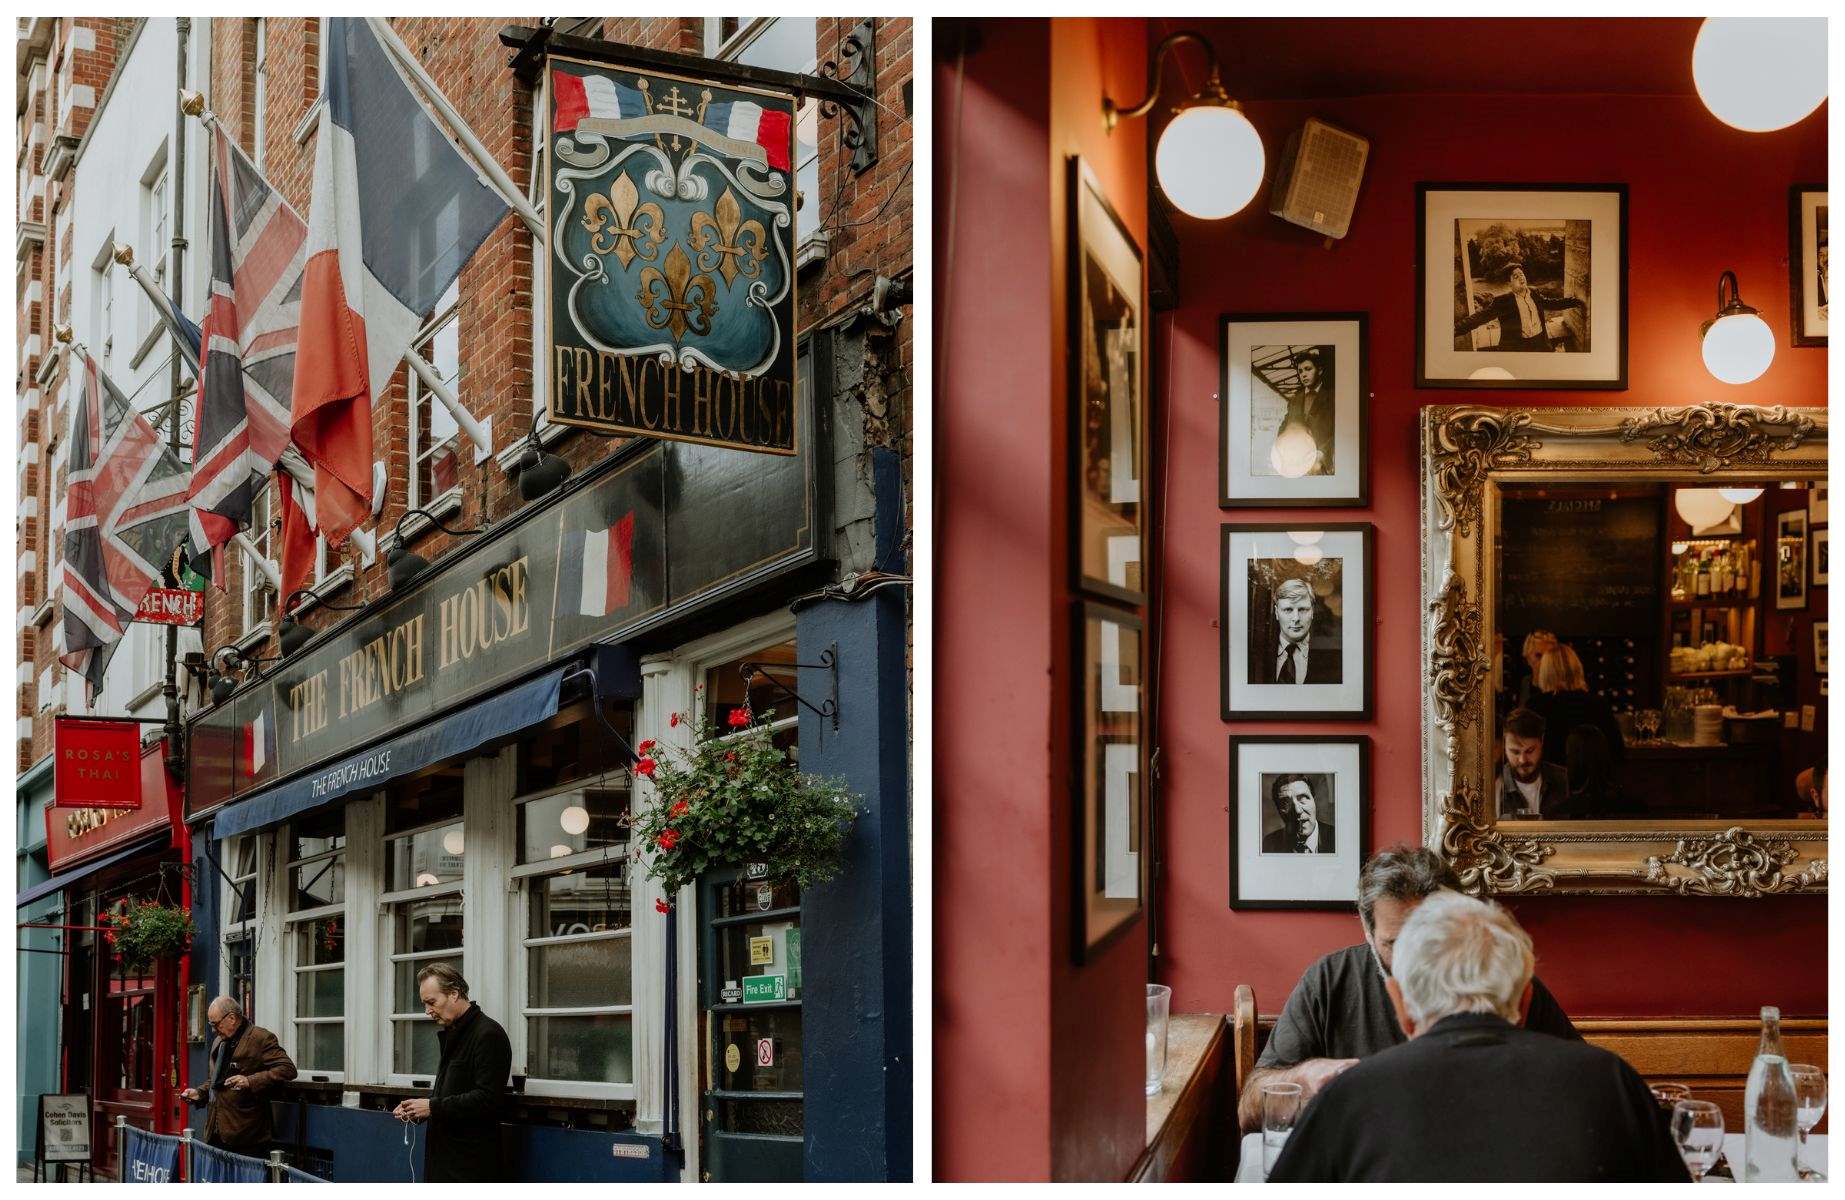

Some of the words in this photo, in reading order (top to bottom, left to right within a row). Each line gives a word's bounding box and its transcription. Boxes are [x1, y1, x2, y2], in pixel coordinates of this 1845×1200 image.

[553, 345, 682, 430] FRENCH
[692, 366, 791, 447] HOUSE
[139, 591, 196, 616] RENCH
[289, 669, 328, 743] THE
[338, 612, 425, 720] FRENCH
[438, 555, 529, 671] HOUSE
[65, 749, 130, 761] ROSA'S
[77, 768, 120, 780] THAI
[311, 777, 326, 798] THE
[327, 763, 358, 790] FRENCH
[358, 750, 392, 780] HOUSE
[746, 984, 758, 994] Fire
[759, 983, 773, 994] Exit
[45, 1111, 66, 1119] Cohen
[68, 1111, 87, 1119] Davis
